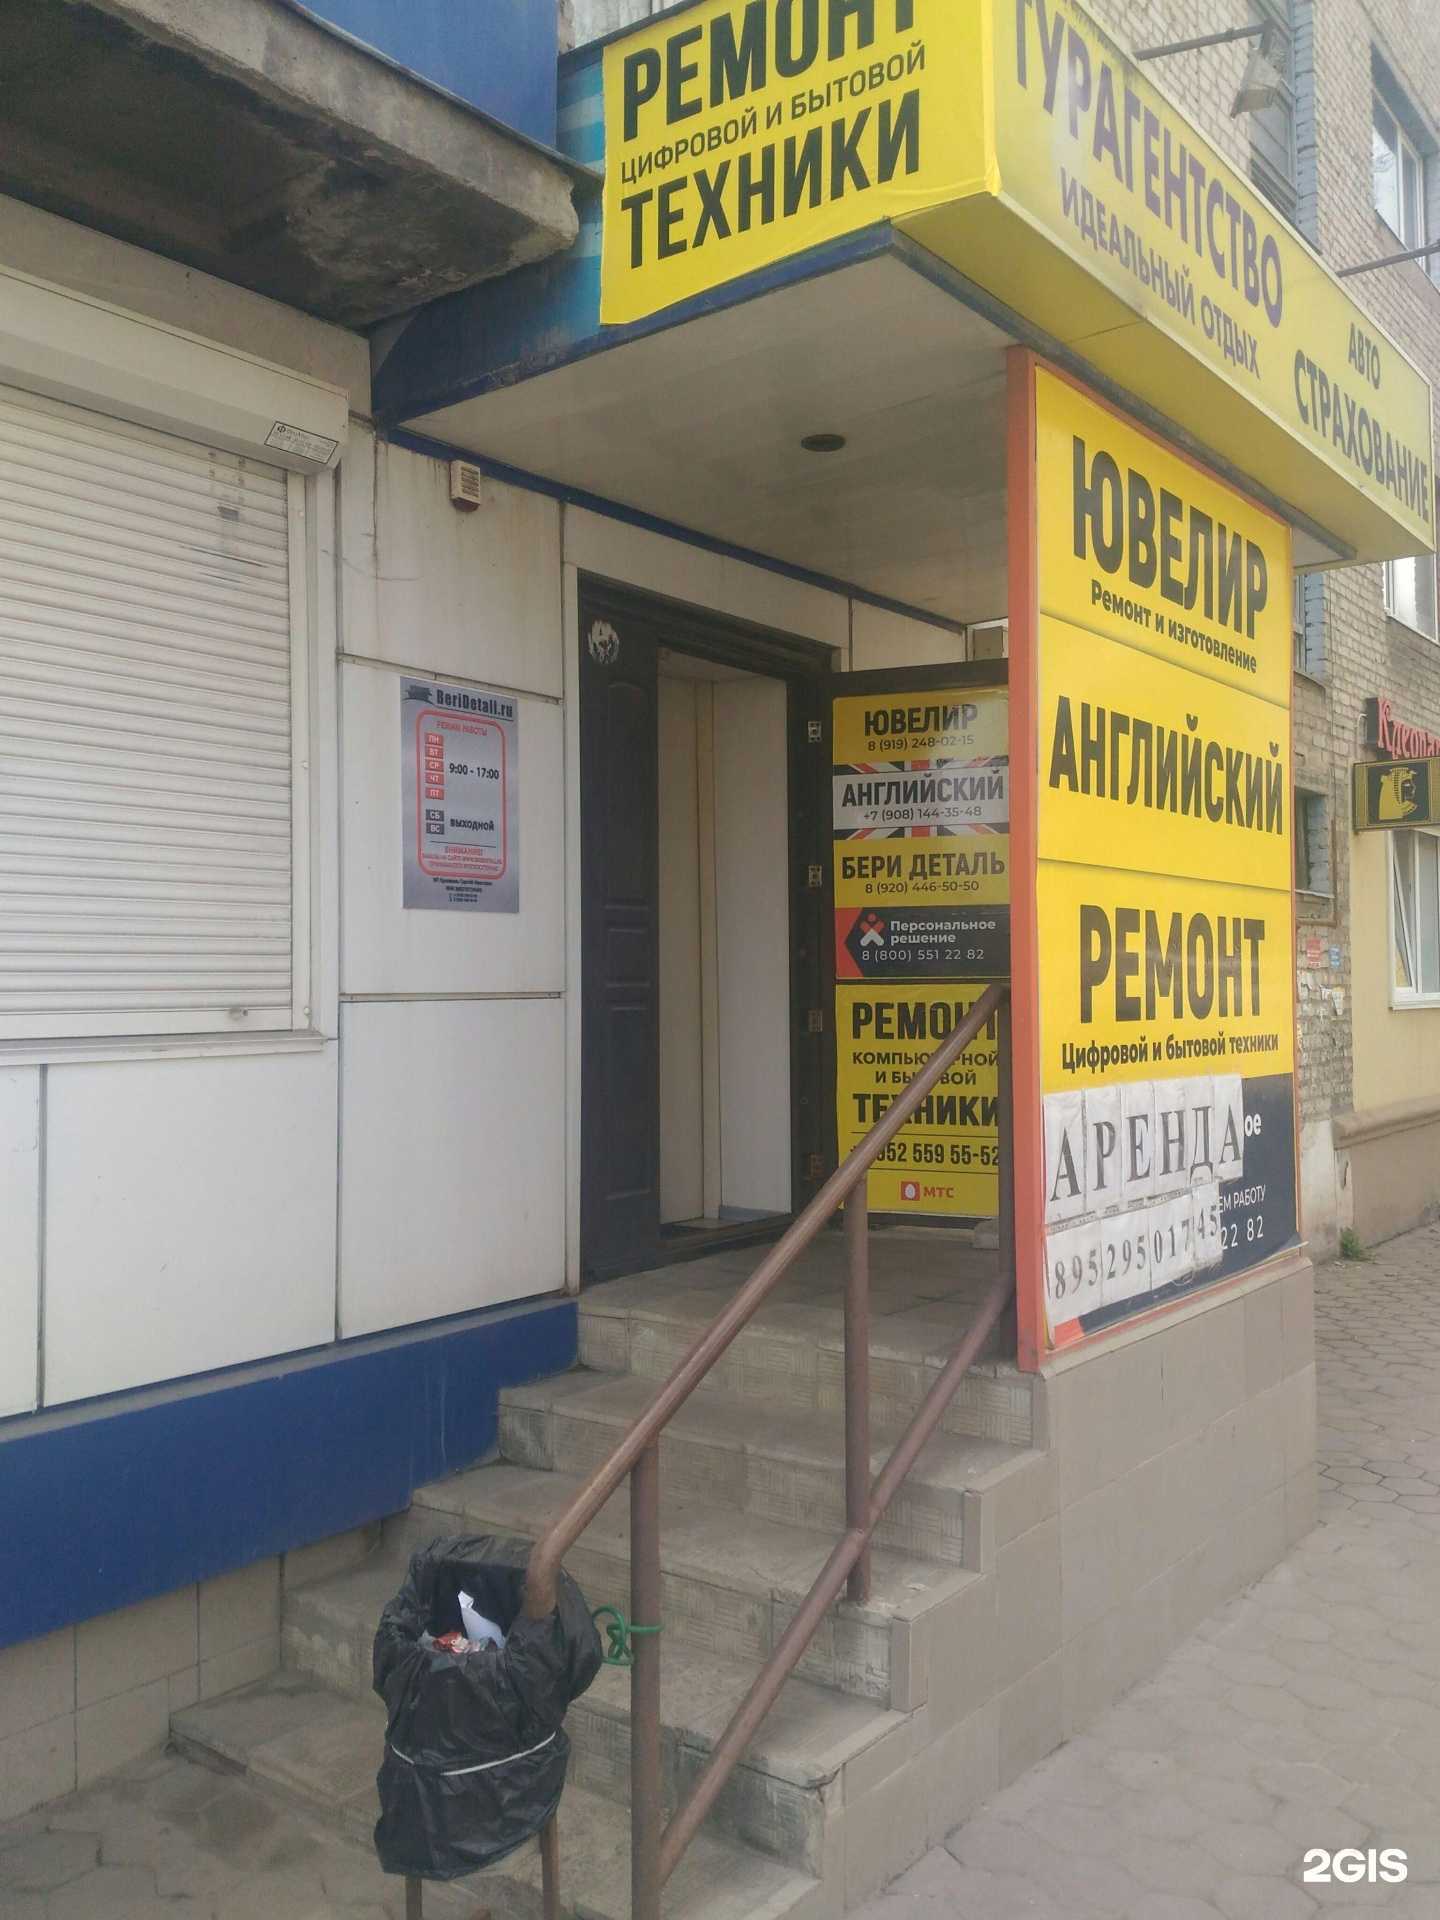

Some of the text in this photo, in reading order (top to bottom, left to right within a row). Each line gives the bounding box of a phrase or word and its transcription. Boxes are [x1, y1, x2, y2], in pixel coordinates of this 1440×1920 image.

[620, 39, 926, 184] ЦИФРОВОЙ И БЫТОВОЙ
[620, 88, 920, 269] ТЕХНИКИ
[1060, 166, 1260, 380] ИДЕАЛЬНЫЙ ОТДЫХ
[1347, 322, 1381, 390] АВТО
[1294, 349, 1430, 525] СТРАХОВАНИЕ
[1073, 434, 1268, 640] ЮВЕЛИР
[1091, 579, 1257, 674] Ремонт и изготовление
[864, 703, 978, 736] ЮВЕЛИР
[868, 735, 974, 753] 8 (919) 248-02-15
[449, 763, 468, 775] 9:00
[477, 767, 499, 780] 17:00
[1049, 695, 1283, 835] АНГЛИЙСКИЙ
[430, 789, 440, 798] ПТ
[842, 769, 1004, 807] АНГЛИЙСКИЙ
[430, 810, 440, 820] СБ
[864, 806, 982, 823] +7 (908) 144-35-48
[842, 851, 1005, 881] БЕРИ ДЕТАЛЬ
[865, 880, 979, 895] 8 (920) 446-50-50
[890, 919, 996, 931] Персональное
[890, 933, 957, 946] решение
[862, 949, 984, 962] 8 (800) 551 22 82
[1080, 904, 1265, 1024] РЕМОНТ
[852, 1050, 998, 1066] КОМПЬЮНОЙ
[1062, 1030, 1279, 1073] Цифровой и бытовой техники
[875, 1069, 976, 1085] И БЫВОЙ
[852, 1093, 998, 1127] ТЕНИКИ
[913, 1143, 944, 1163] 559
[951, 1145, 998, 1166] 55-52
[1050, 1104, 1242, 1201] АРЕНДА
[1233, 1184, 1266, 1208] РАБОТУ
[1247, 1215, 1263, 1241] 82
[1055, 1205, 1219, 1300] 89529501745
